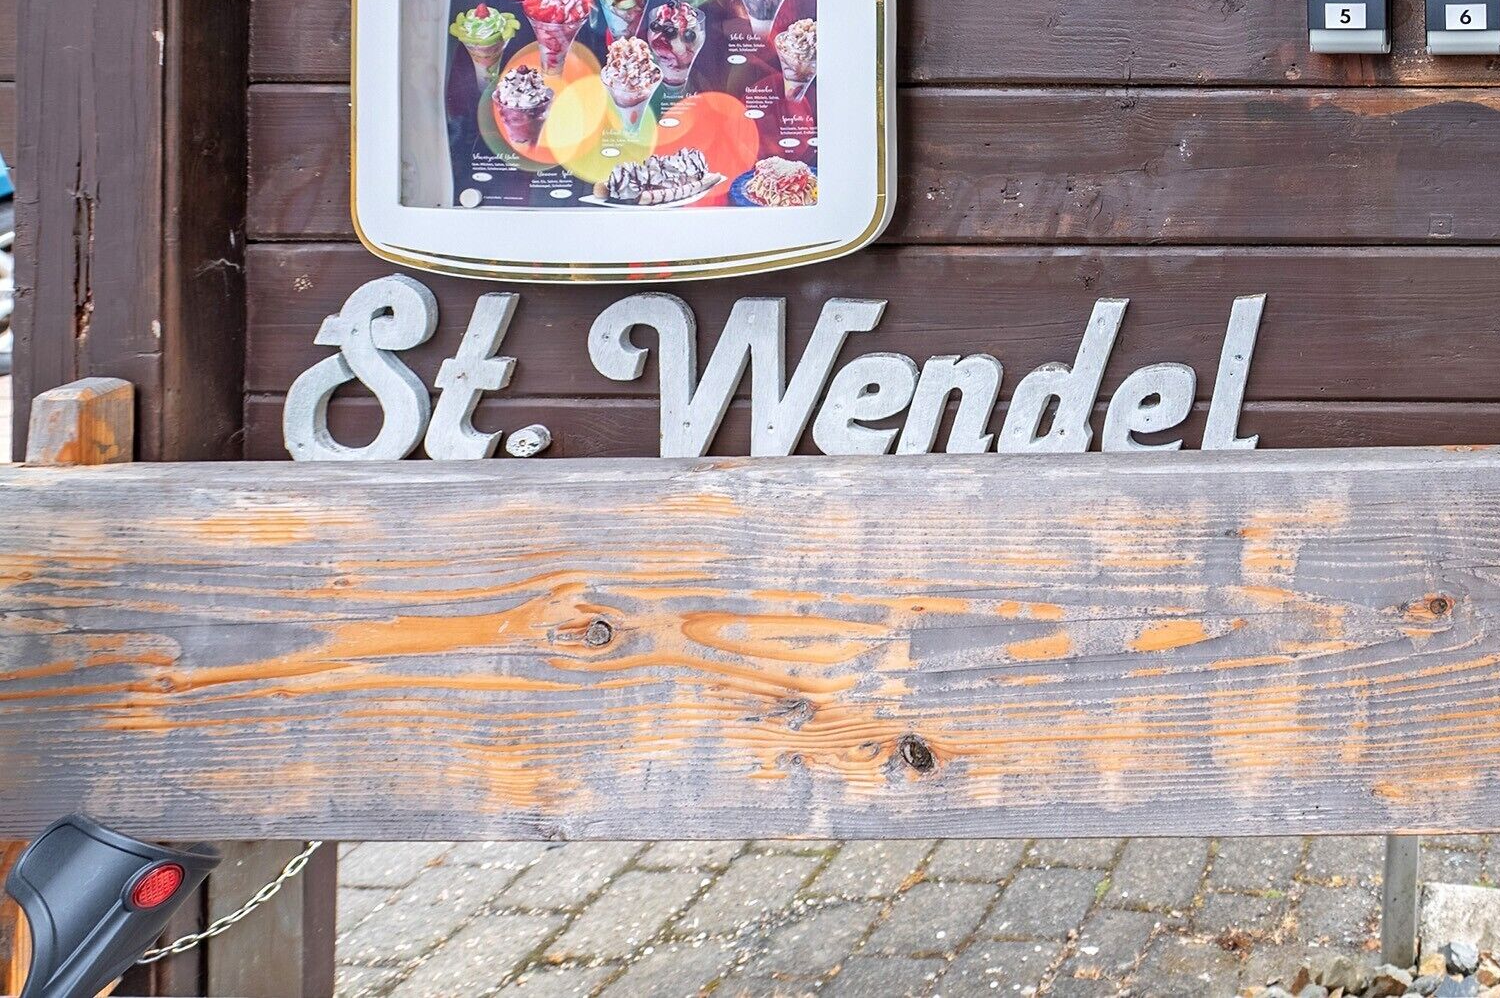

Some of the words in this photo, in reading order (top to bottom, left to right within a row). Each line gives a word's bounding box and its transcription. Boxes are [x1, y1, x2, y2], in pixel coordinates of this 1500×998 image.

[1341, 9, 1351, 24] 5
[1460, 9, 1472, 24] 6
[283, 273, 551, 461] St.
[587, 292, 1267, 459] Wendel
